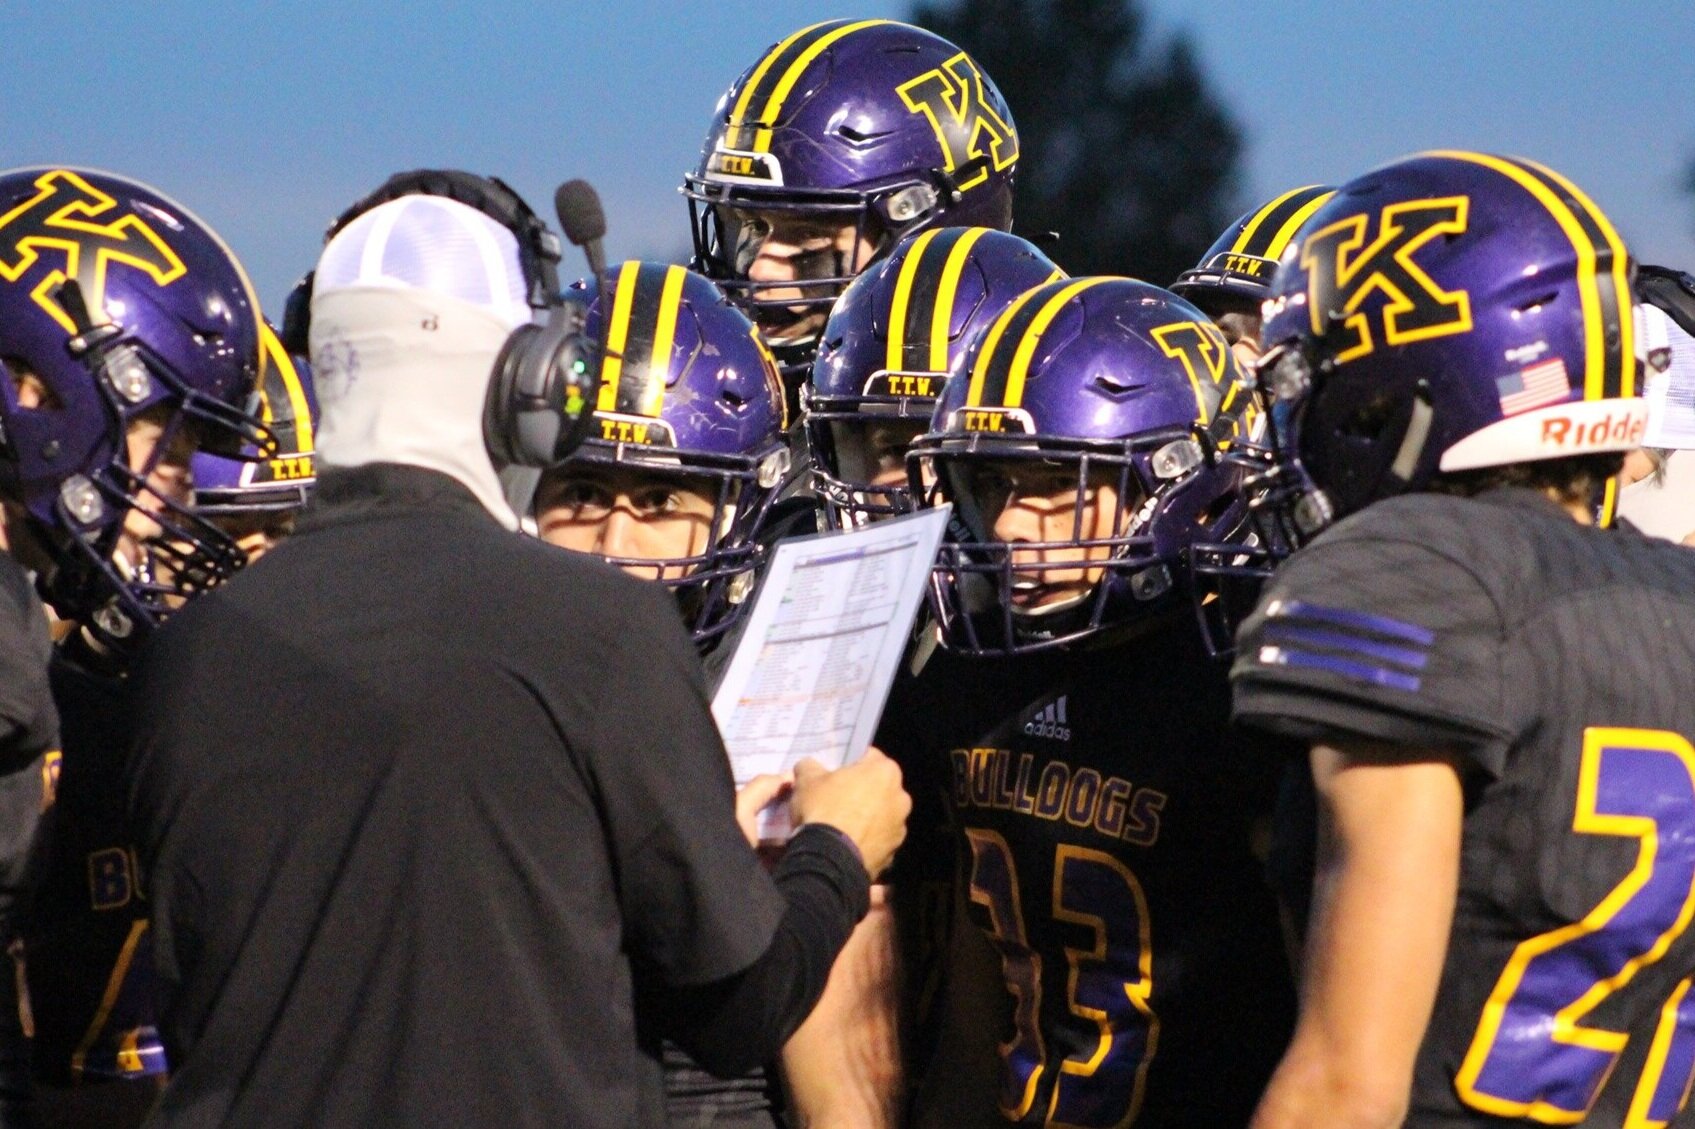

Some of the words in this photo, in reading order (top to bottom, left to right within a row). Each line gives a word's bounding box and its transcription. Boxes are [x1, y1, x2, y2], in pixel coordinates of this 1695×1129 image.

[895, 51, 1020, 191] K
[0, 169, 187, 335] K
[1301, 196, 1473, 362] K
[1540, 411, 1646, 447] Ridde
[1023, 719, 1071, 741] adidas
[950, 747, 1167, 848] BULLDOGS
